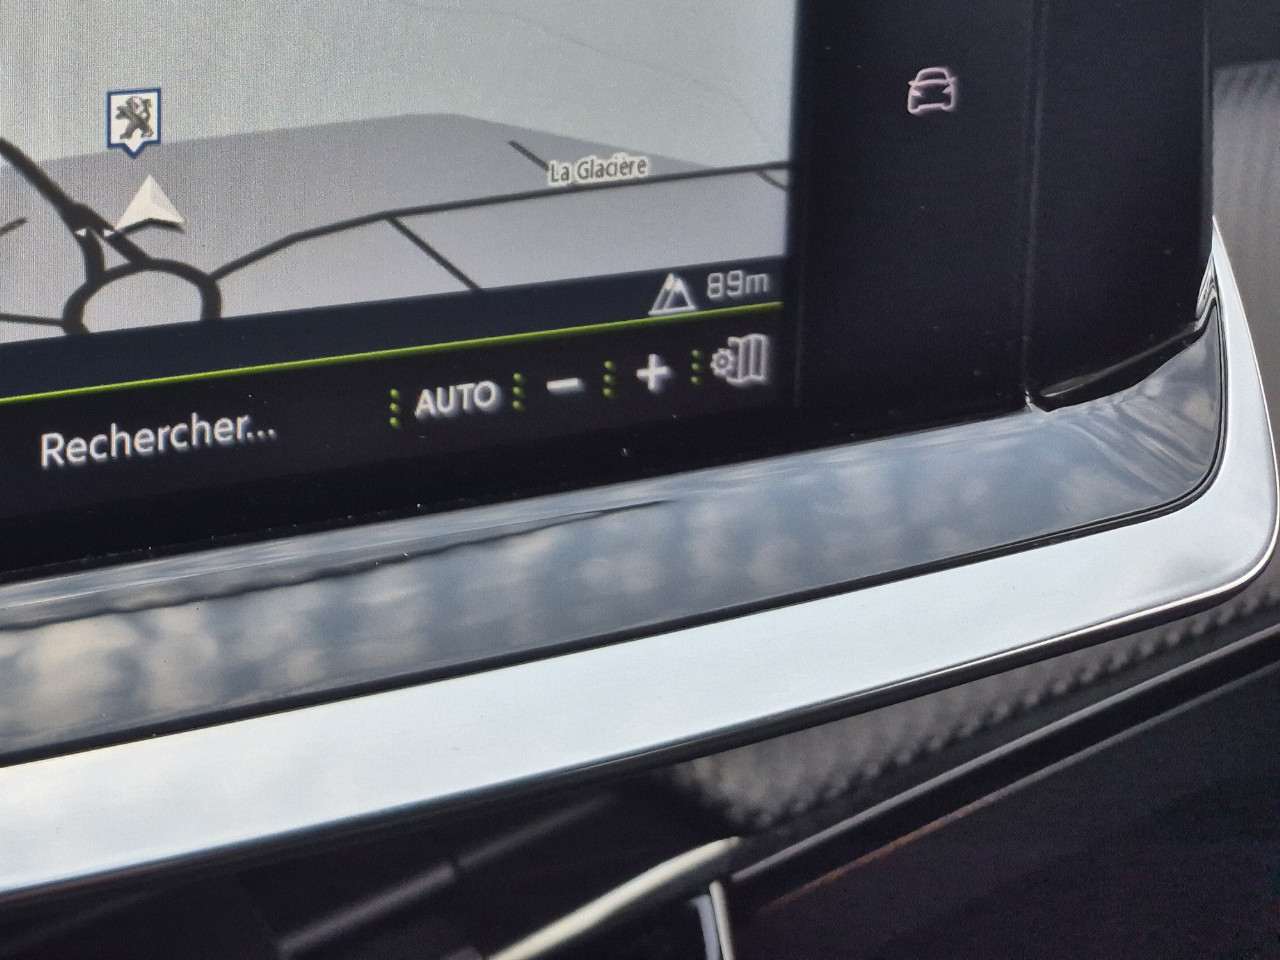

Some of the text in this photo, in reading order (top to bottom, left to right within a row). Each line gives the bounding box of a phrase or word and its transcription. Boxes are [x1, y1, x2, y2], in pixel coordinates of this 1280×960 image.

[551, 157, 647, 182] La Glacière
[707, 270, 768, 299] 89m
[414, 380, 498, 418] AUTO
[40, 412, 276, 468] Rechercher...
